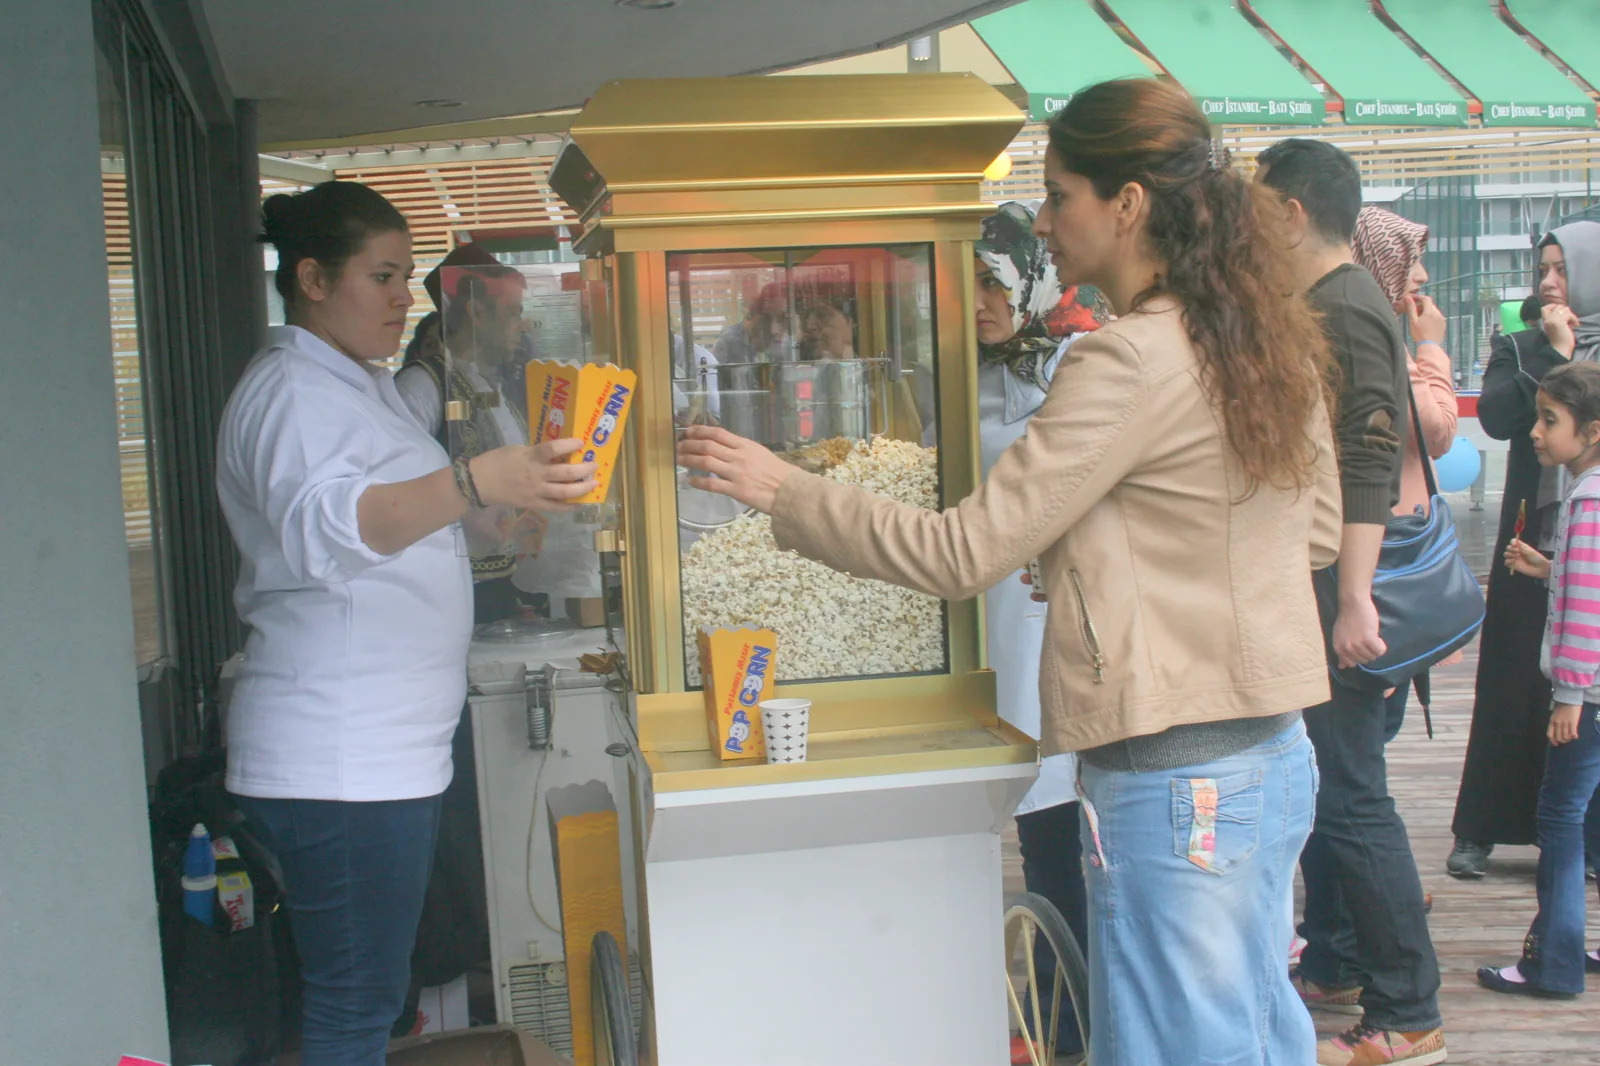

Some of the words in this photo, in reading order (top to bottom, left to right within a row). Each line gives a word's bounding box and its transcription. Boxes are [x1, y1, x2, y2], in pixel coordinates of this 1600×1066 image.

[546, 376, 571, 440] CORN
[592, 383, 630, 447] CORN
[725, 710, 751, 753] POP
[739, 645, 772, 707] CORN
